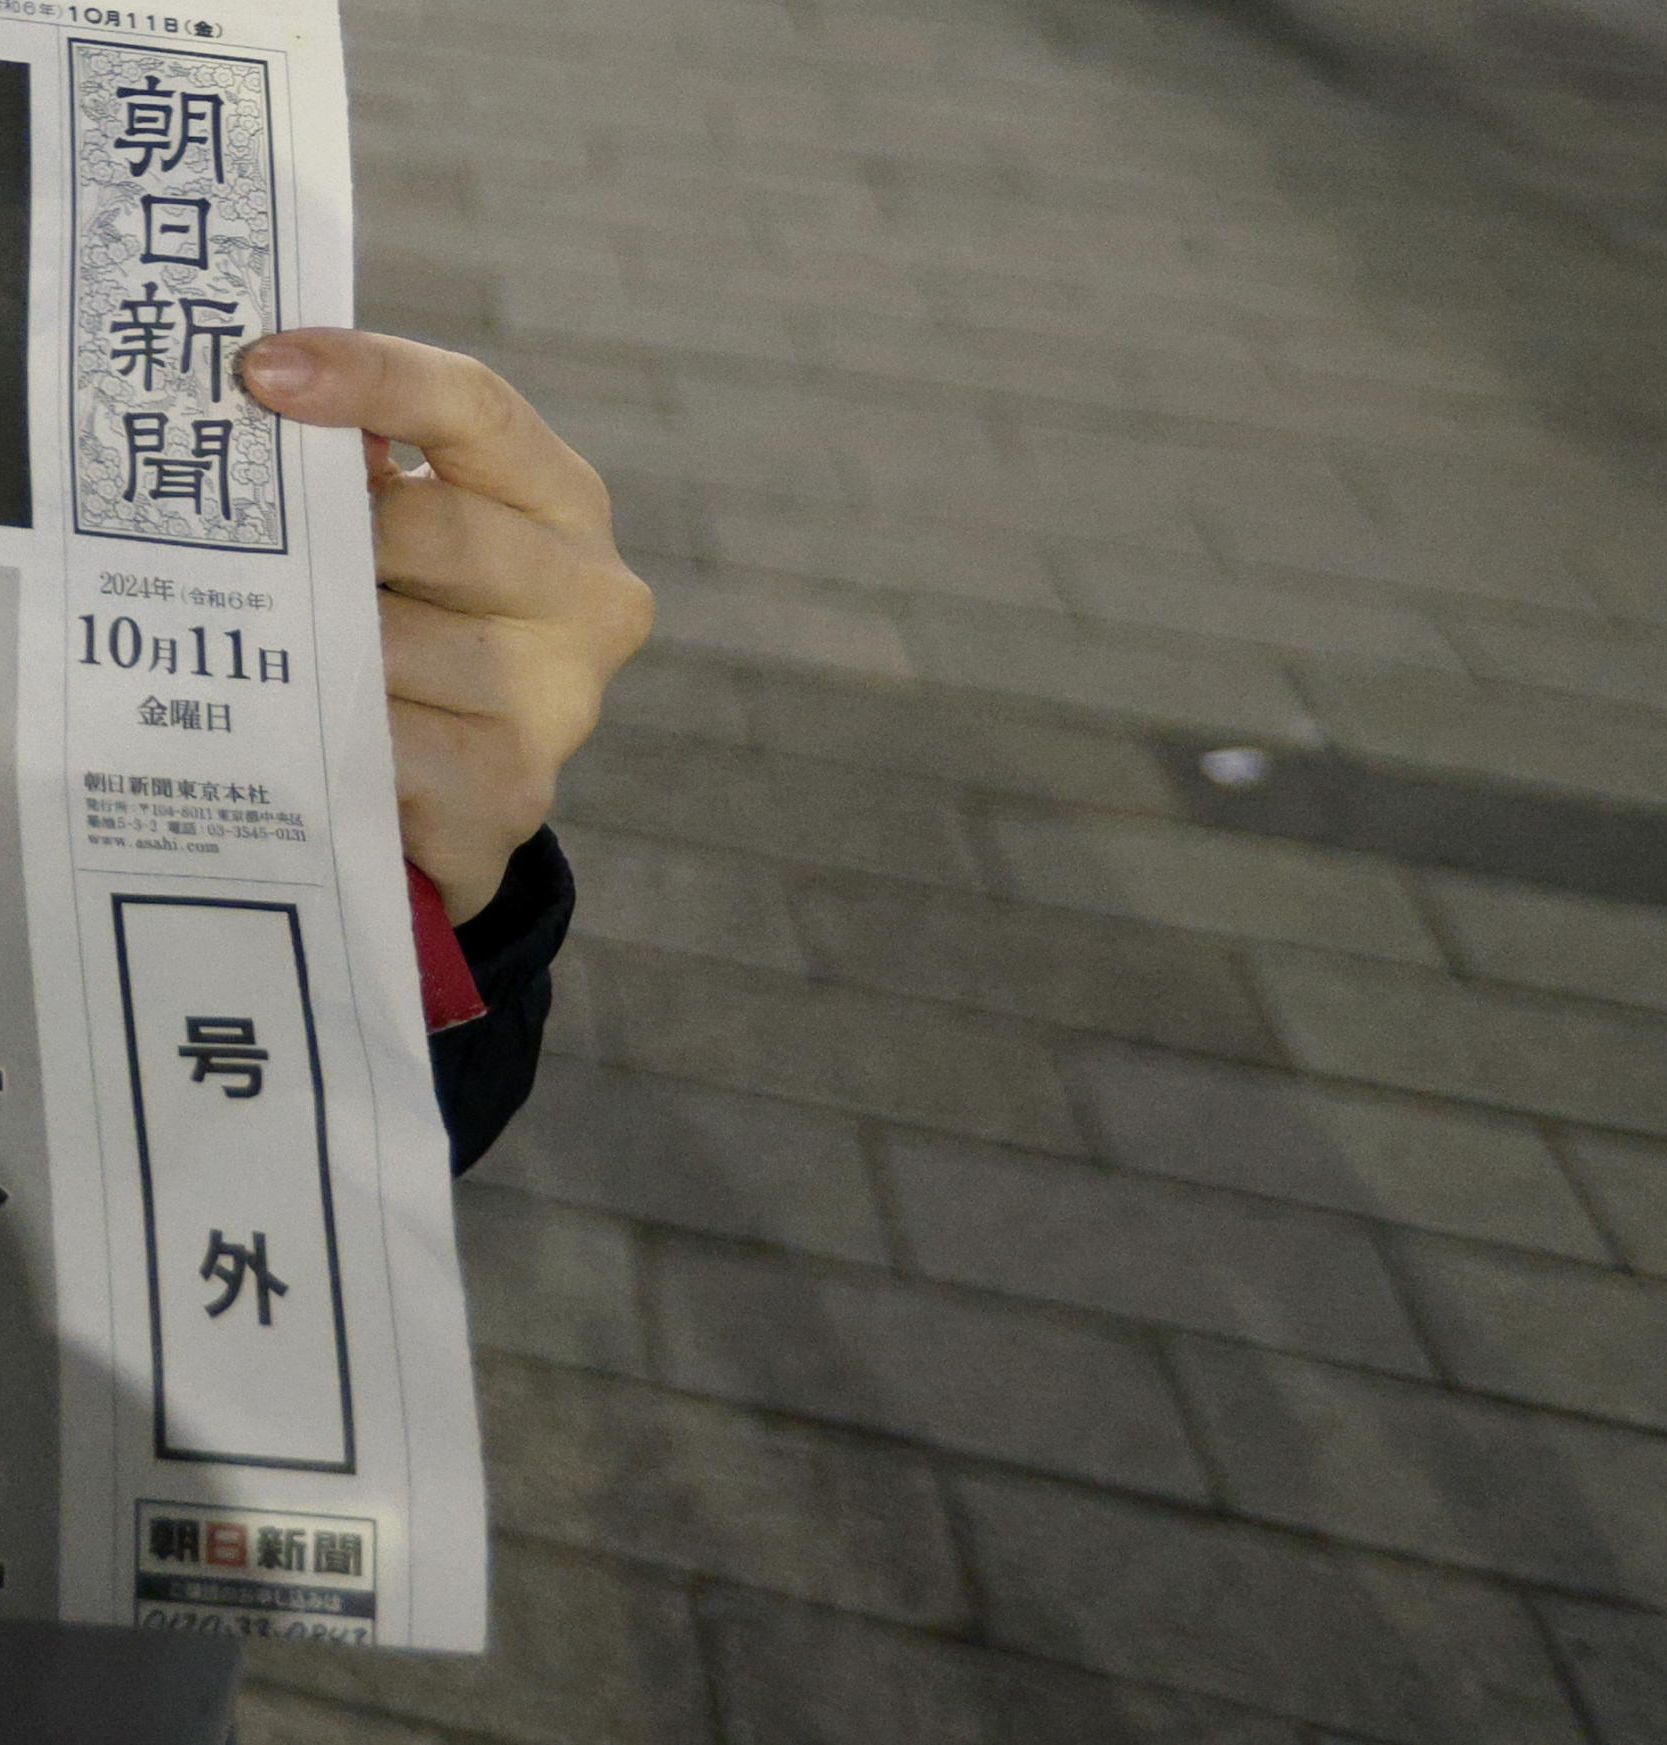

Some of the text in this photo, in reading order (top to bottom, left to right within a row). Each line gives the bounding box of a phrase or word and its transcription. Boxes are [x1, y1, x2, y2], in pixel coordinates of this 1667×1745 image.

[110, 75, 245, 521] 朝日新聞
[78, 613, 291, 684] 10月11日
[138, 695, 233, 733] 金曜日
[83, 770, 271, 805] 朝日新聞東京本社
[177, 1013, 290, 1327] 号外
[149, 1515, 363, 1577] 朝日新聞
